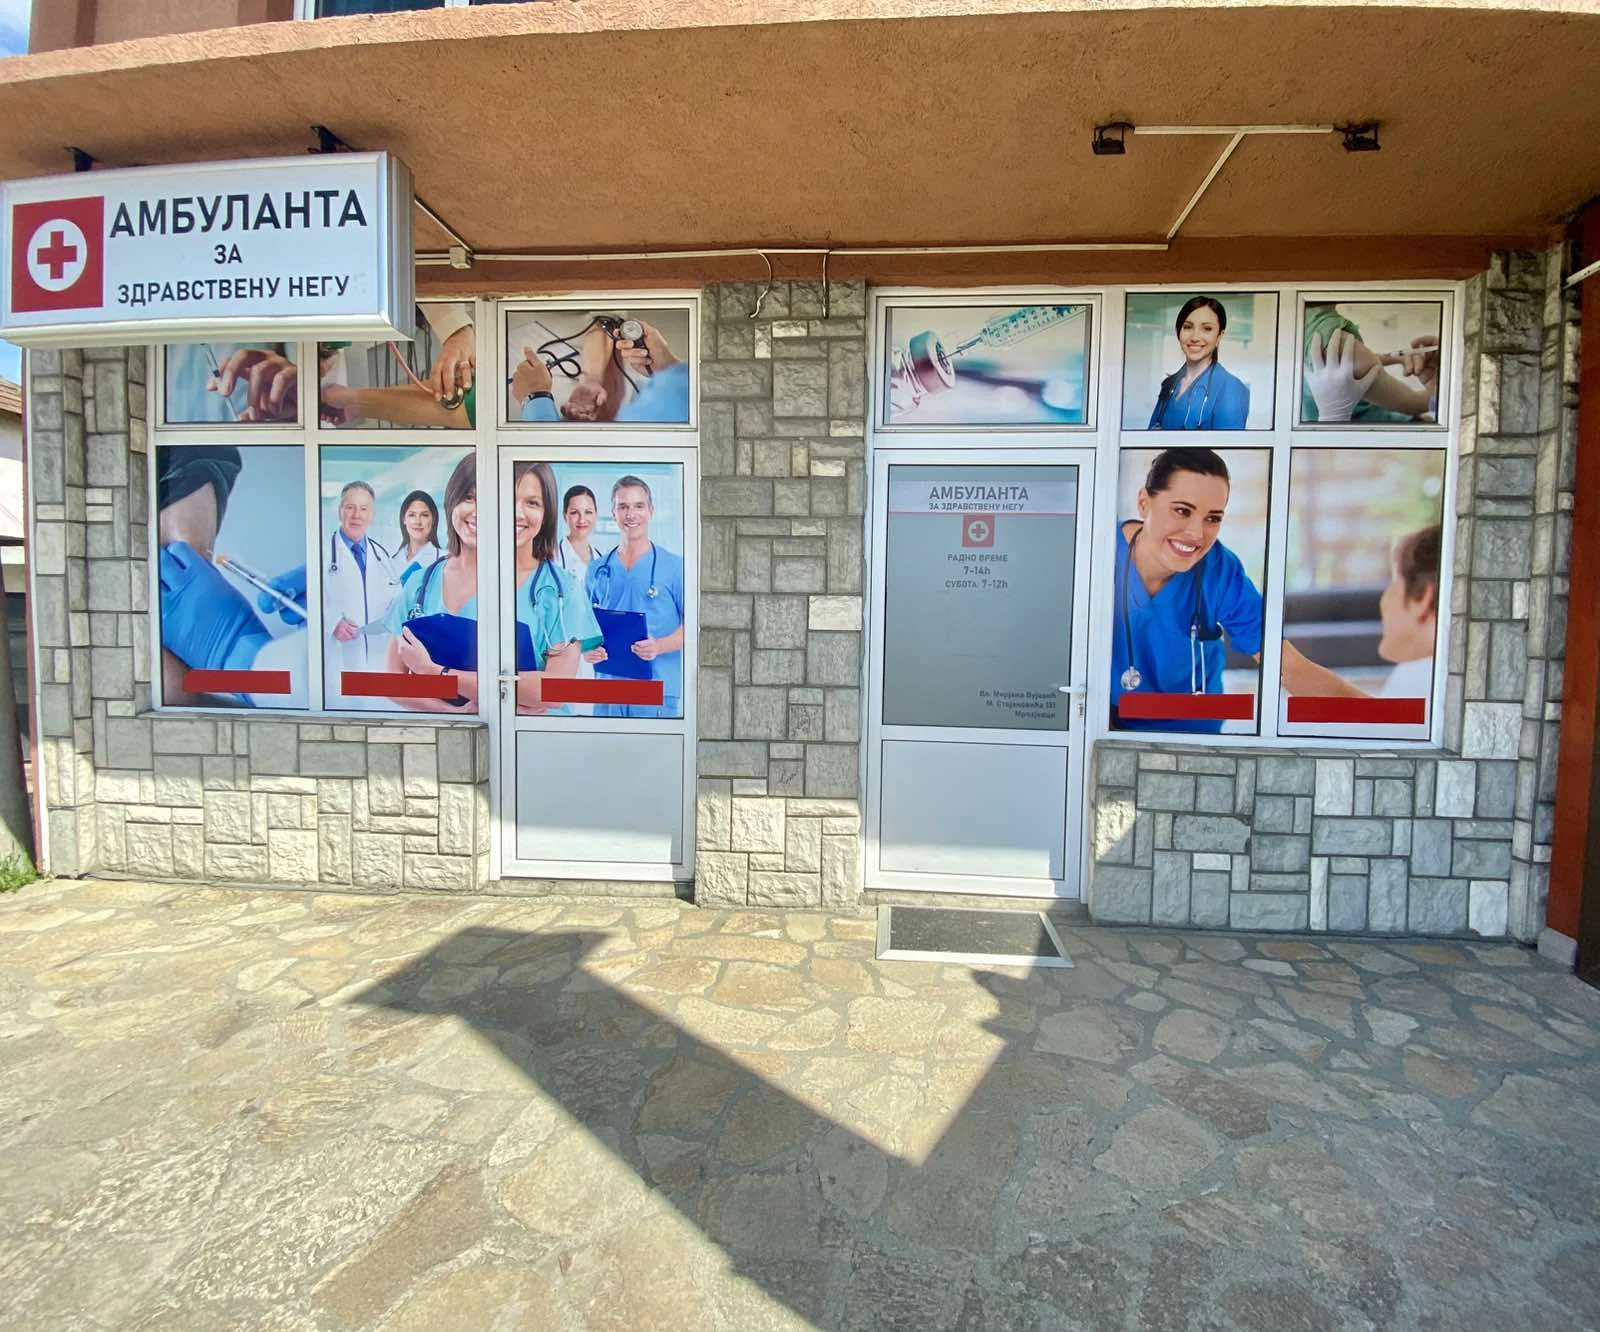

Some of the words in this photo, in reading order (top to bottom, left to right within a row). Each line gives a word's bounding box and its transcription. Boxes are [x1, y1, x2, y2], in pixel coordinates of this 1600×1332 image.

[109, 188, 369, 239] АМБУЛАНТА
[213, 243, 243, 265] ЗА
[117, 276, 281, 307] ЗДРАВСТВЕНУ
[288, 274, 350, 298] НЕГУ
[929, 486, 1029, 500] АМБУЛАНТА
[929, 502, 940, 511] ЗА
[942, 502, 1001, 512] ЗДРАВСТВЕНУ
[1002, 503, 1025, 512] НЕГУ
[947, 553, 978, 563] РАДНО
[978, 554, 1009, 563] ВРЕМЕ
[963, 565, 991, 576] 7-14h
[981, 579, 1009, 590] 7-12h
